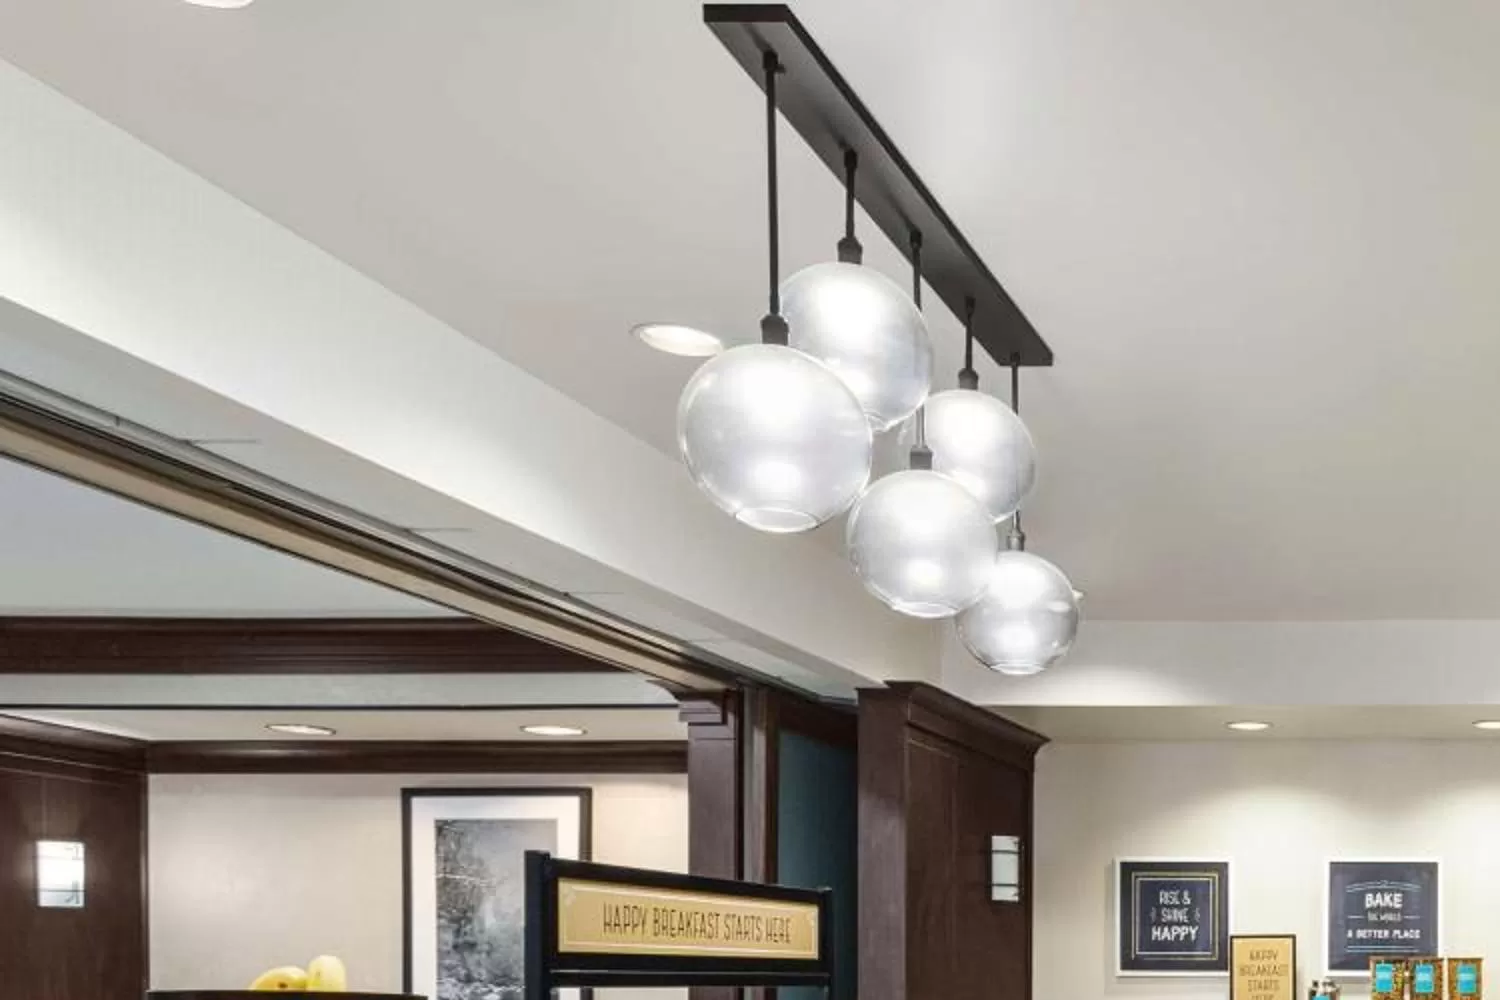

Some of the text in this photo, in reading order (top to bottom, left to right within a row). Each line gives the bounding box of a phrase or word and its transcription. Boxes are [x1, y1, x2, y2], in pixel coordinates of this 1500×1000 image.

[1365, 892, 1404, 909] BAKE
[603, 903, 792, 945] HAPPY BREAKFAST STARTS HERE
[1151, 925, 1199, 941] HAPPY
[1356, 929, 1390, 938] BETTER
[1392, 929, 1421, 939] PLACE
